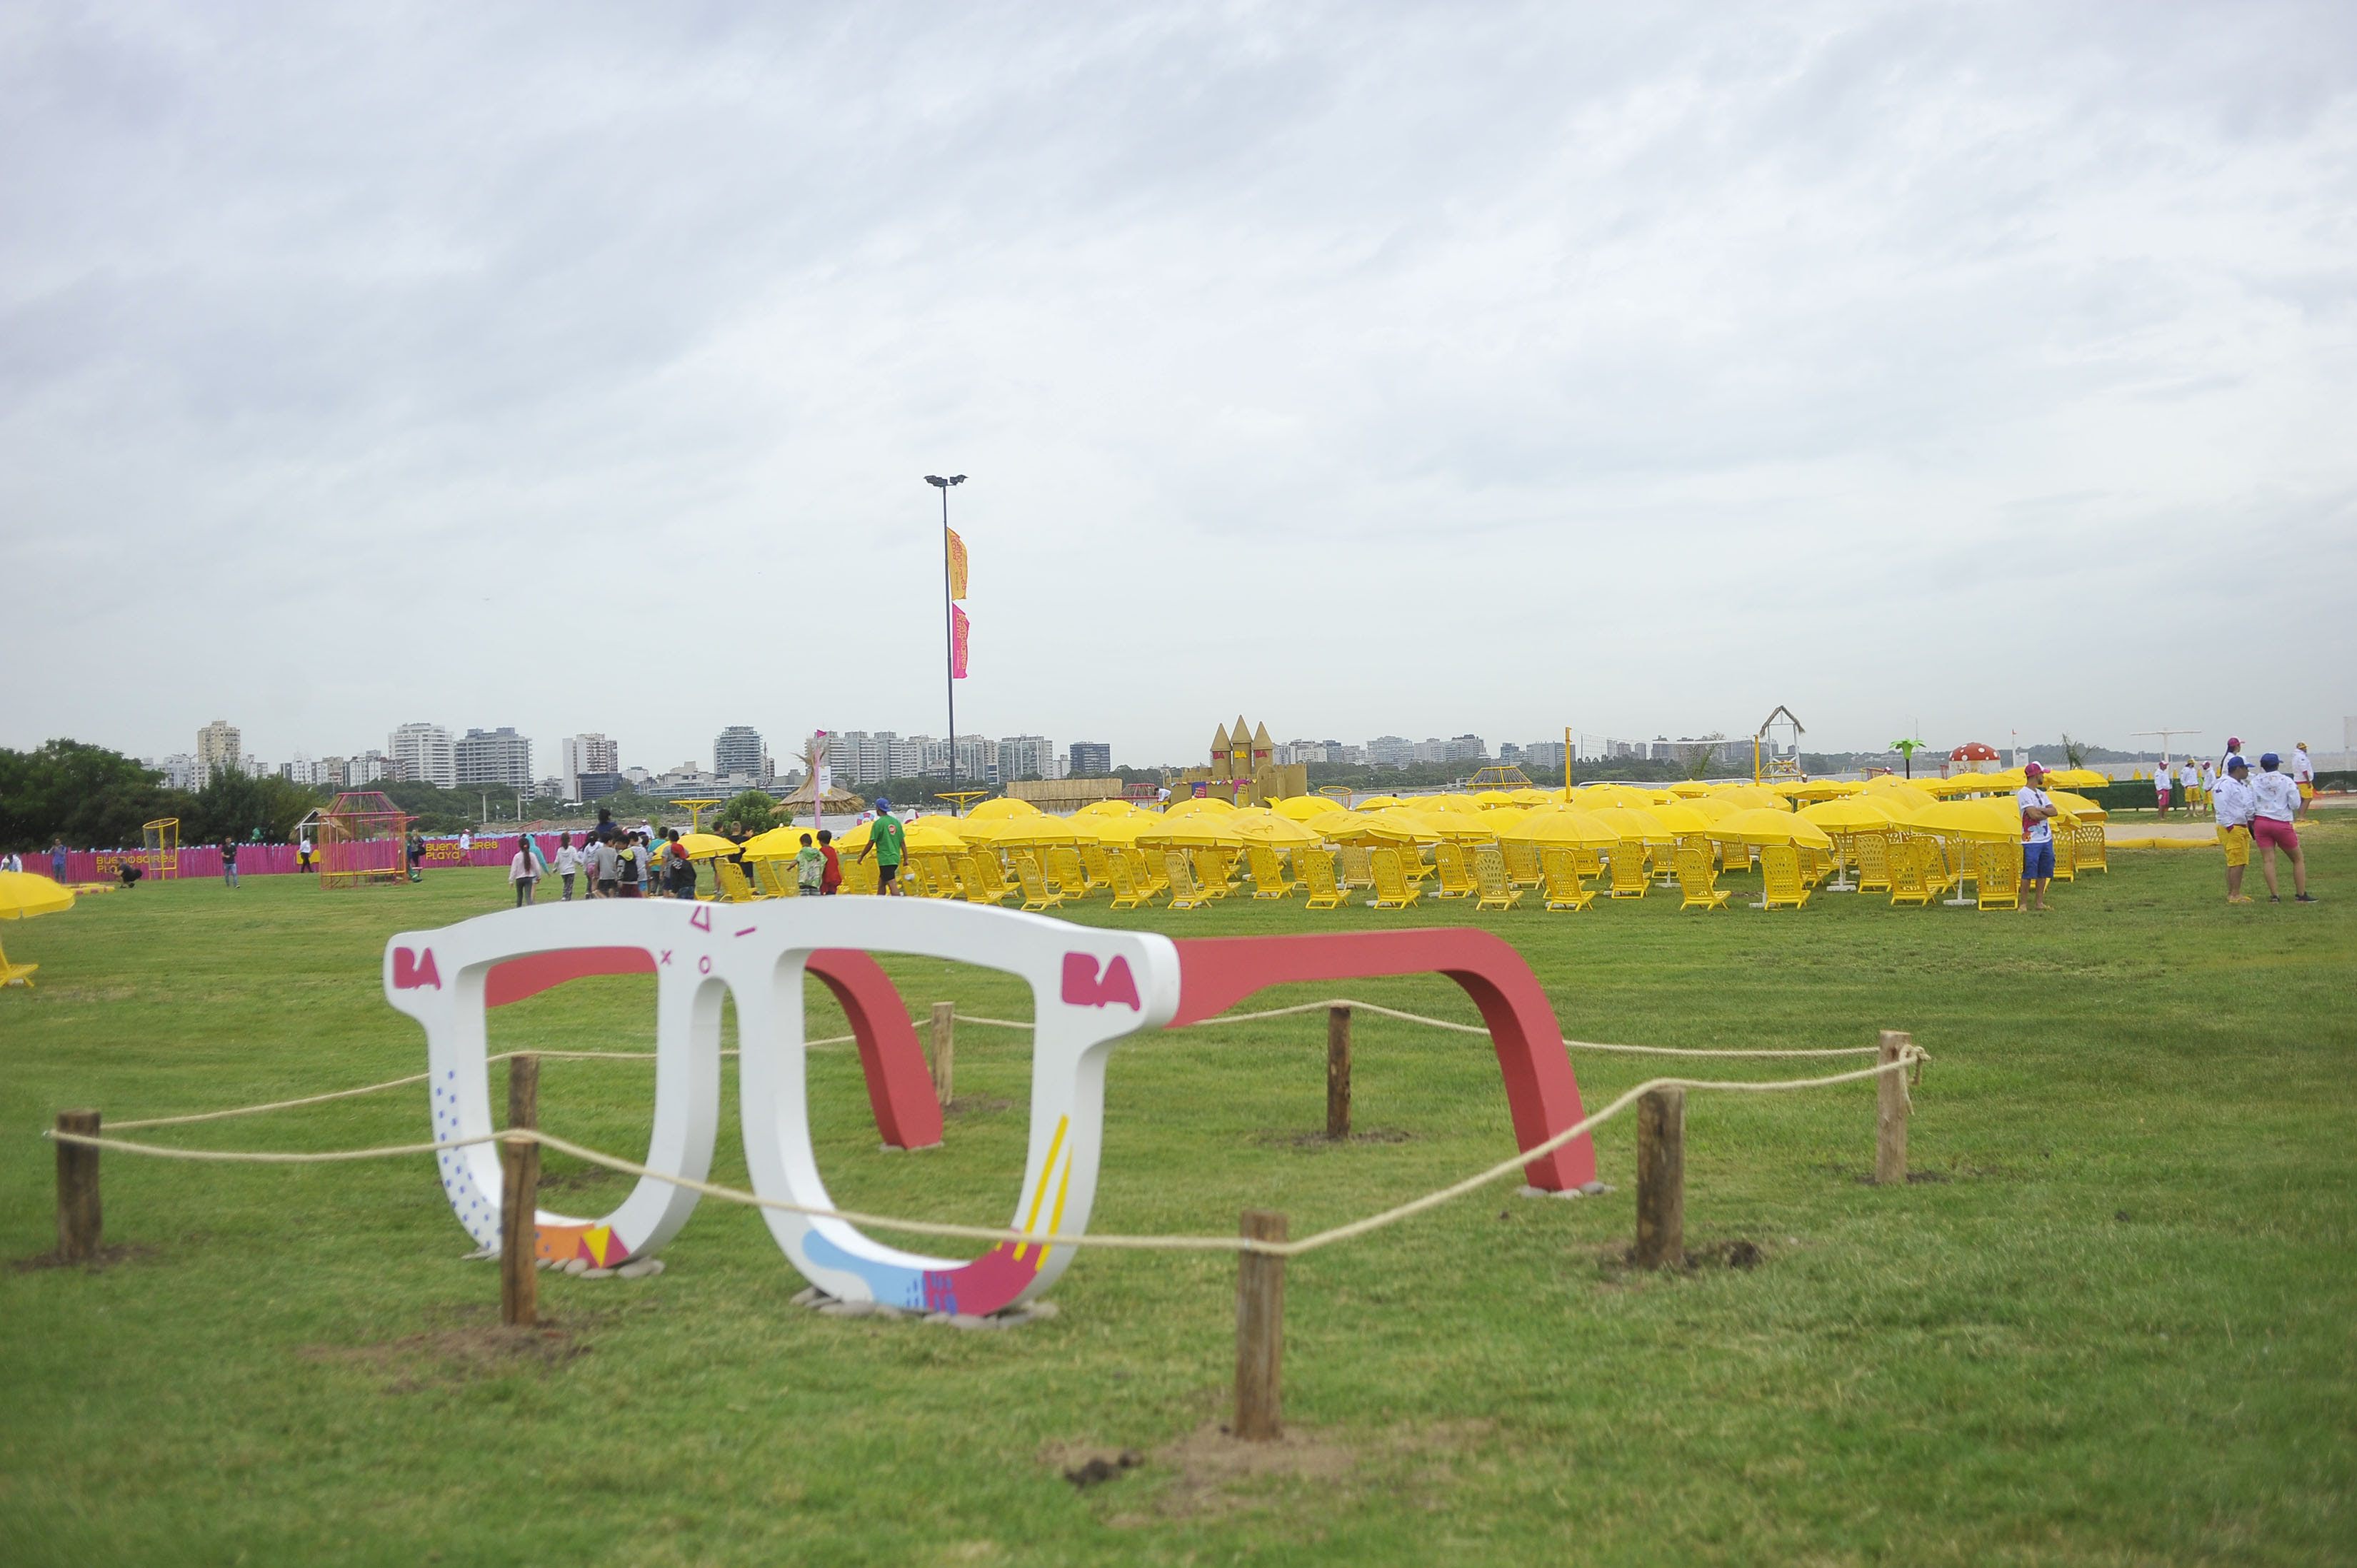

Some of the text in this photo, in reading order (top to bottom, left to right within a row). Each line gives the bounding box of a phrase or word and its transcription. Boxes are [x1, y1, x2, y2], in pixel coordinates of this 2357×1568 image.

[1233, 750, 1248, 759] BA
[1255, 750, 1268, 758] BA
[393, 947, 441, 990] BA
[1062, 952, 1140, 1011] BA
